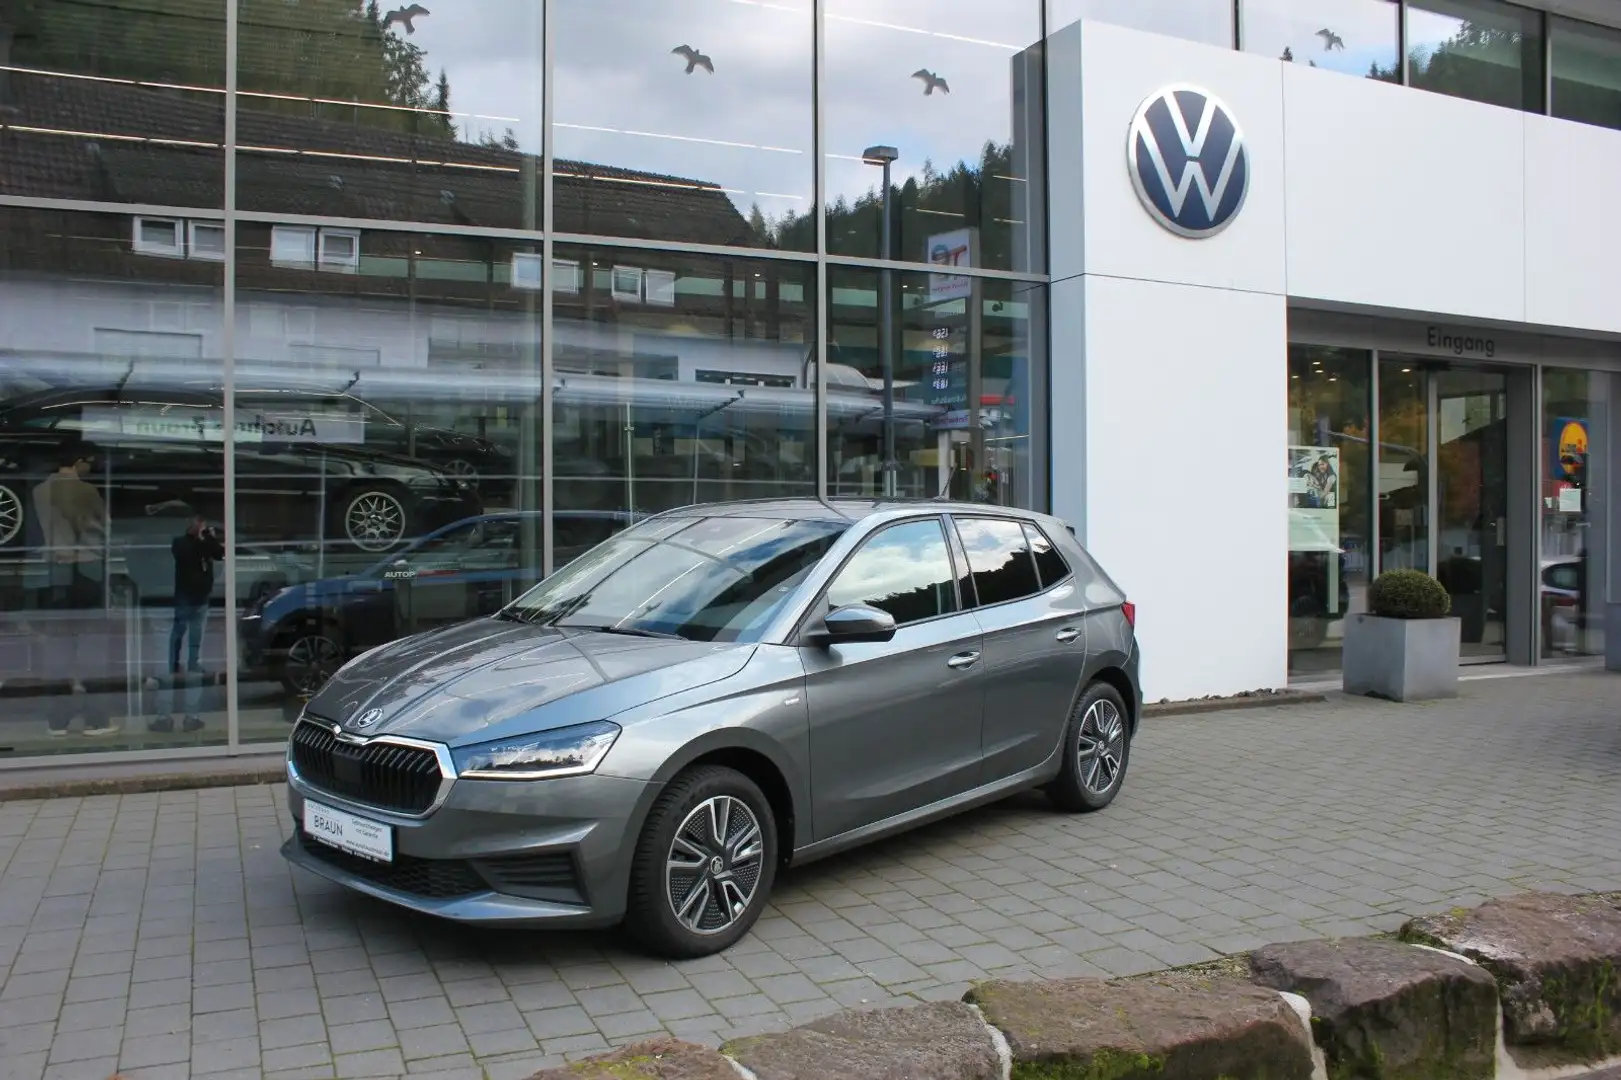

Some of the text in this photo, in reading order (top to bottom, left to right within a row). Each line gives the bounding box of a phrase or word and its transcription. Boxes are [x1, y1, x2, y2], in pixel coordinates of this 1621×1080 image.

[1130, 84, 1247, 226] VW
[1427, 326, 1495, 358] Eingang
[313, 815, 343, 836] BRAUN
